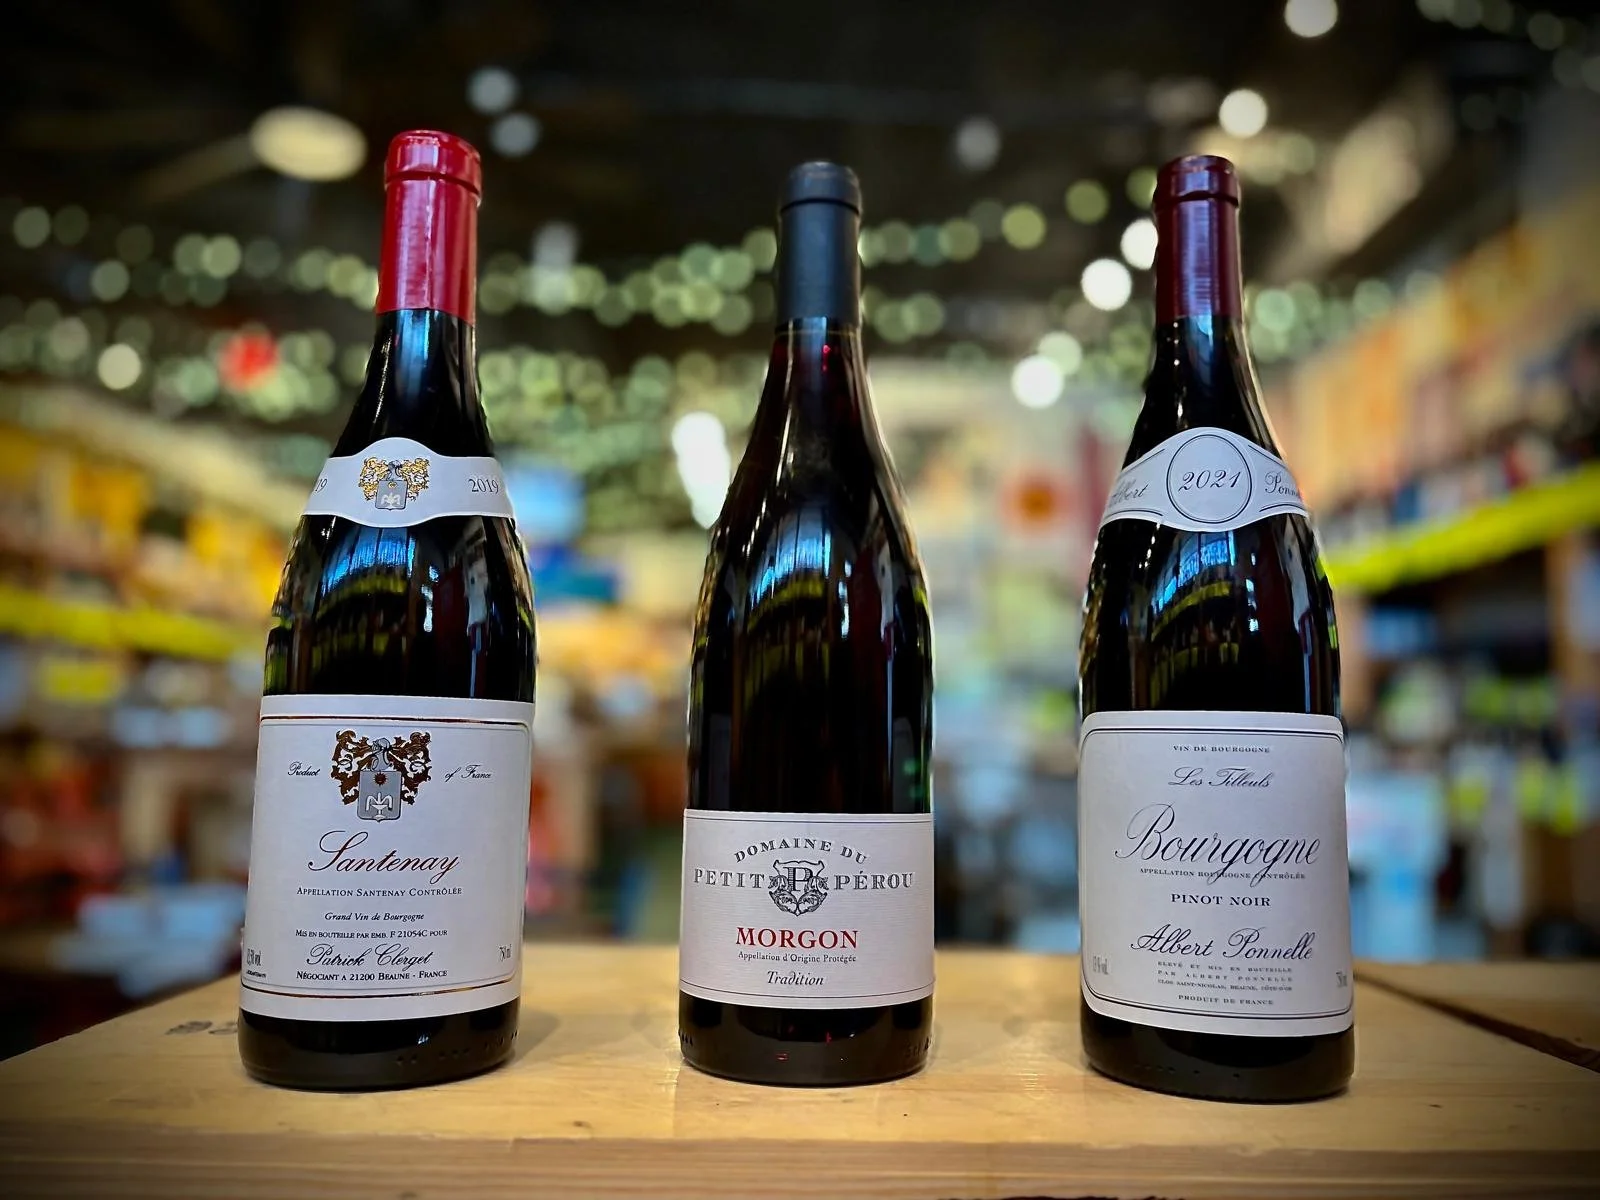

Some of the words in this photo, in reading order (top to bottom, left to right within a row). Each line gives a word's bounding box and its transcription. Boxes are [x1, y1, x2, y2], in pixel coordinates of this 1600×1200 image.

[469, 478, 499, 494] 2019
[1177, 470, 1242, 493] 2021
[287, 761, 321, 777] Product
[445, 767, 460, 783] of
[461, 765, 492, 780] France
[1167, 766, 1204, 787] Les
[1208, 767, 1275, 788] Tilleuls
[733, 837, 833, 864] DOMAINE
[839, 845, 868, 865] DU
[1114, 801, 1321, 888] Bourgogne
[308, 830, 460, 885] Santenay
[693, 867, 766, 890] PETIT
[833, 870, 914, 891] PÉROU
[1140, 868, 1195, 876] APPELLATION
[1171, 893, 1223, 905] PINOT
[1229, 896, 1271, 906] NOIR
[324, 911, 353, 921] Grand
[354, 912, 369, 921] Vin
[370, 912, 381, 921] de
[383, 912, 425, 923] Bourgogne
[735, 927, 858, 949] MORGON
[1130, 923, 1213, 957] Albert
[1222, 927, 1316, 960] Ponnelle
[306, 943, 373, 966] Patrick
[374, 943, 434, 972] Clerget
[738, 951, 780, 962] Appellation
[782, 953, 821, 964] d'Origine
[823, 954, 857, 965] Protégée
[349, 973, 376, 981] 21200
[767, 970, 825, 986] Tradition
[1178, 995, 1219, 1003] PRODUIT
